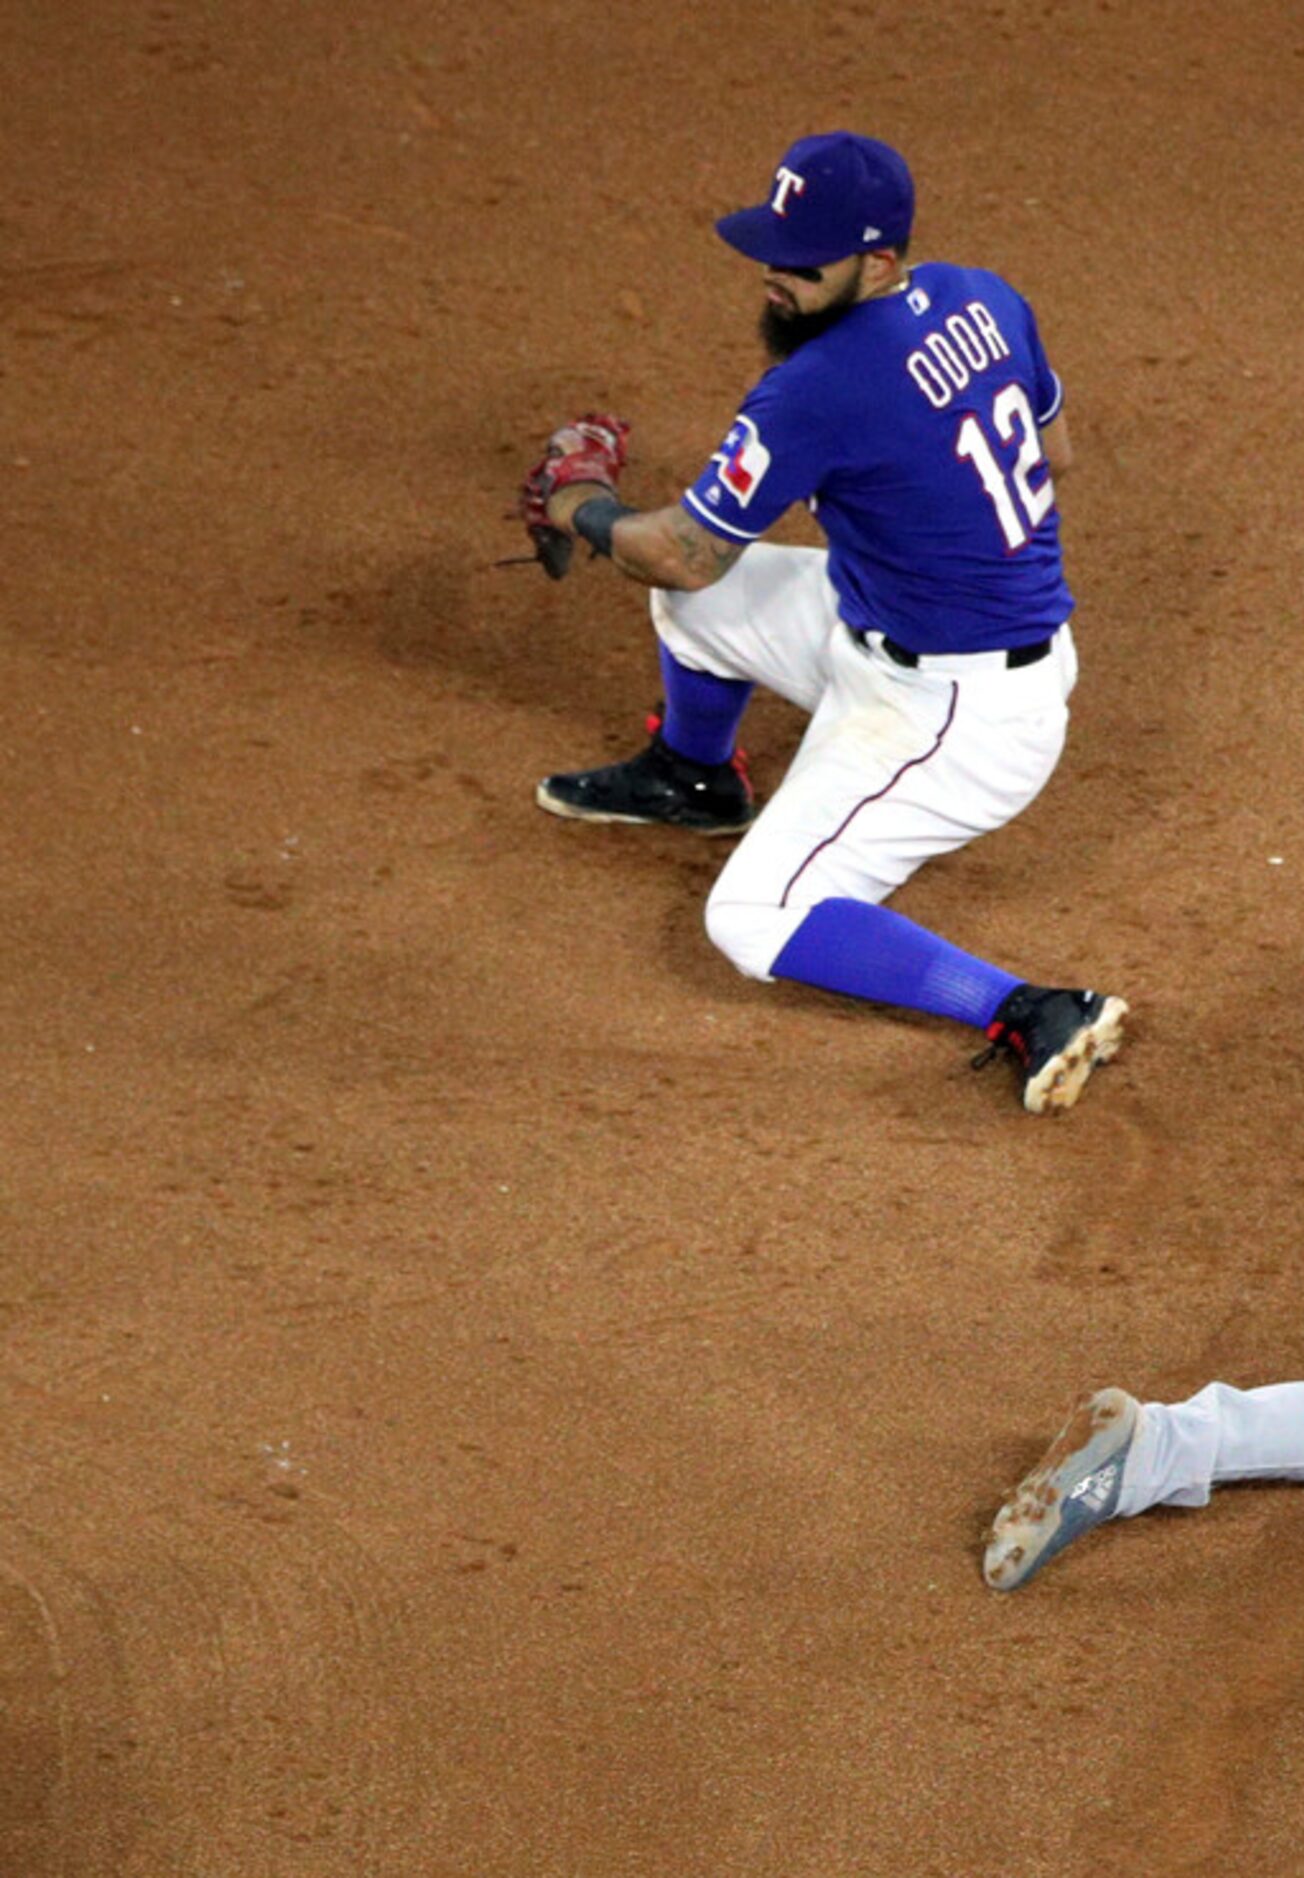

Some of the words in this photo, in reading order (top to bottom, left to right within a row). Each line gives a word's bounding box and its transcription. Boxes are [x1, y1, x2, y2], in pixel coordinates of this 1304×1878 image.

[772, 166, 805, 217] T
[906, 300, 1011, 409] ODOR
[956, 380, 1057, 556] 12
